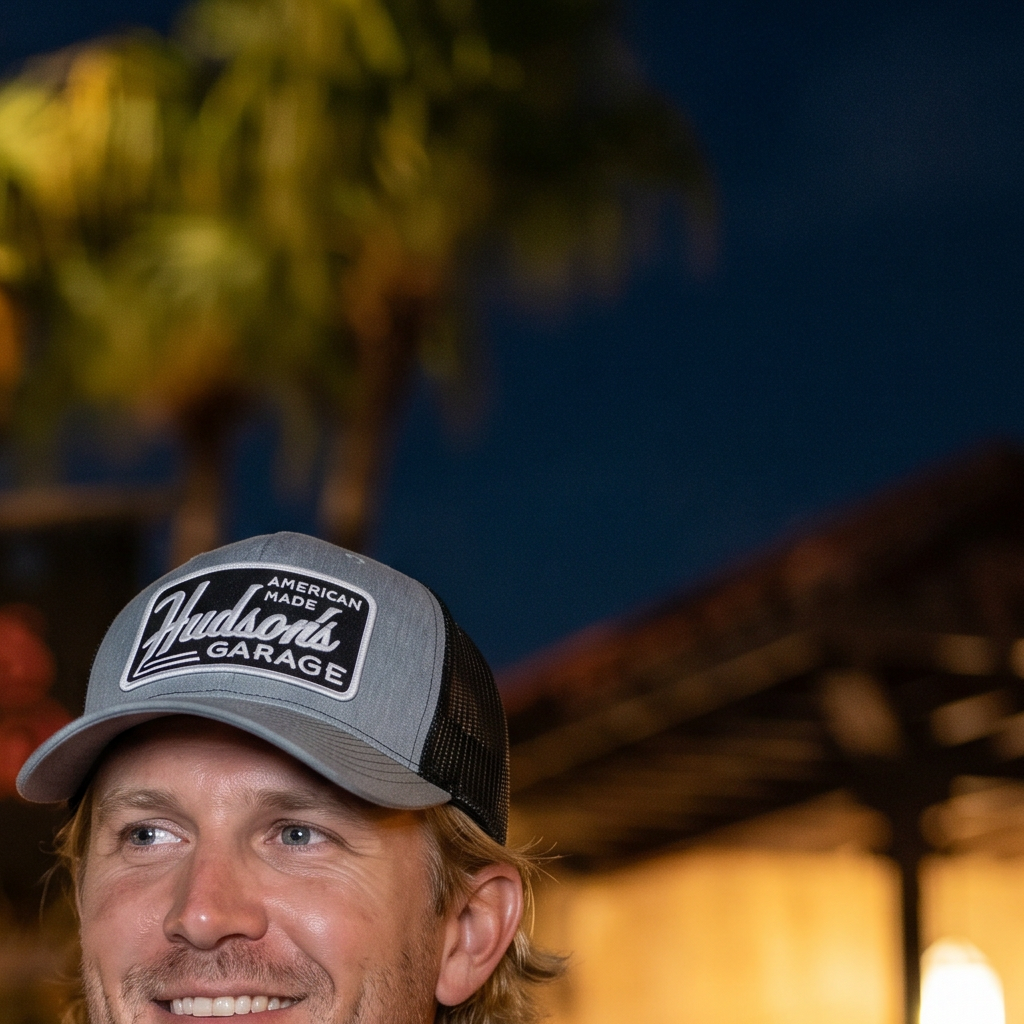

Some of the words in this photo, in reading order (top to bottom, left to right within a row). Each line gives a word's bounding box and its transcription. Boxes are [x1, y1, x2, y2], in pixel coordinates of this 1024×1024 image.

[264, 590, 318, 612] MADE
[267, 576, 363, 612] AMERICAN
[136, 580, 343, 664] Hudson's
[206, 641, 348, 687] GARAGE
